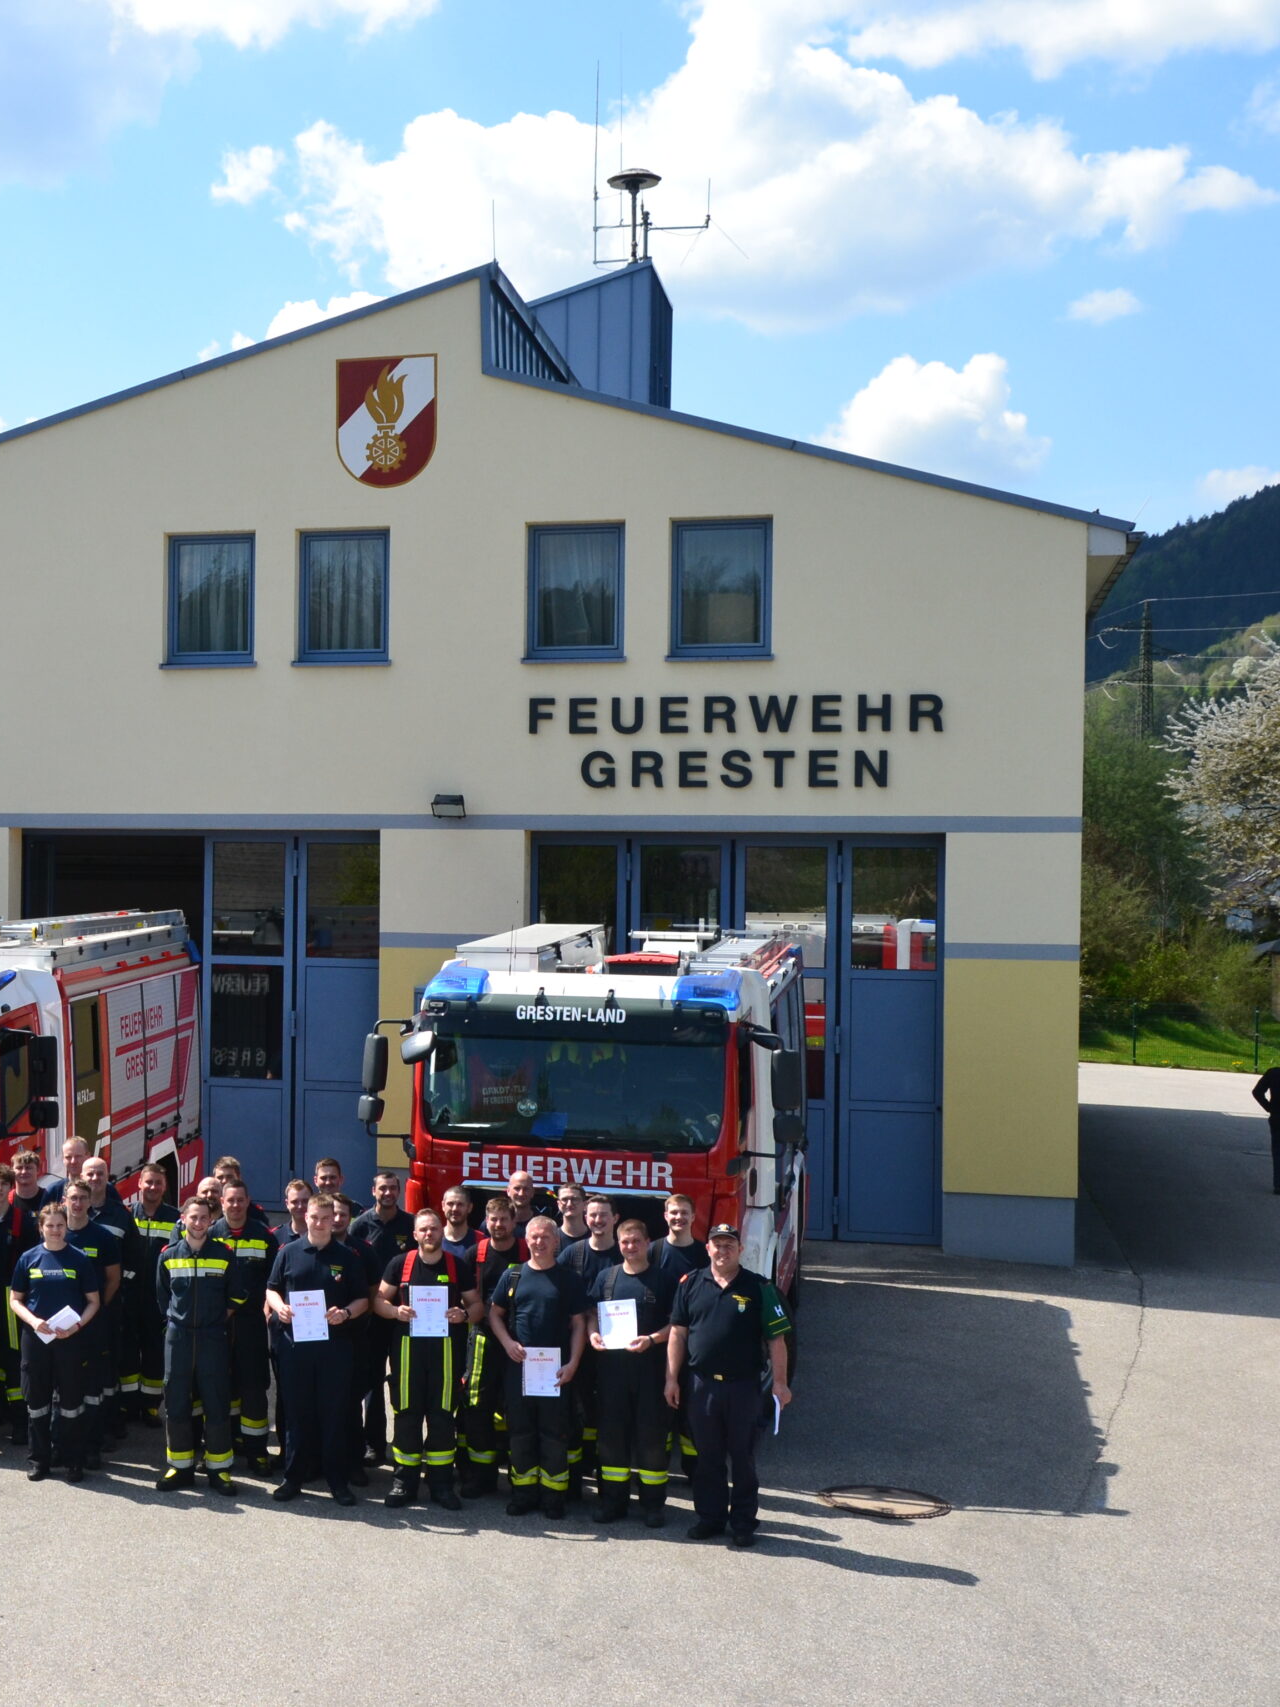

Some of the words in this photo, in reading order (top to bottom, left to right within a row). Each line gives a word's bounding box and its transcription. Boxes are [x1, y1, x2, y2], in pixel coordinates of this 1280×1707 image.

[528, 694, 944, 734] FEUERWEHR
[580, 749, 888, 789] GRESTEN
[516, 1005, 626, 1024] GRESTEN-LAND
[462, 1151, 673, 1188] FEUERWEHR
[774, 1304, 784, 1317] H
